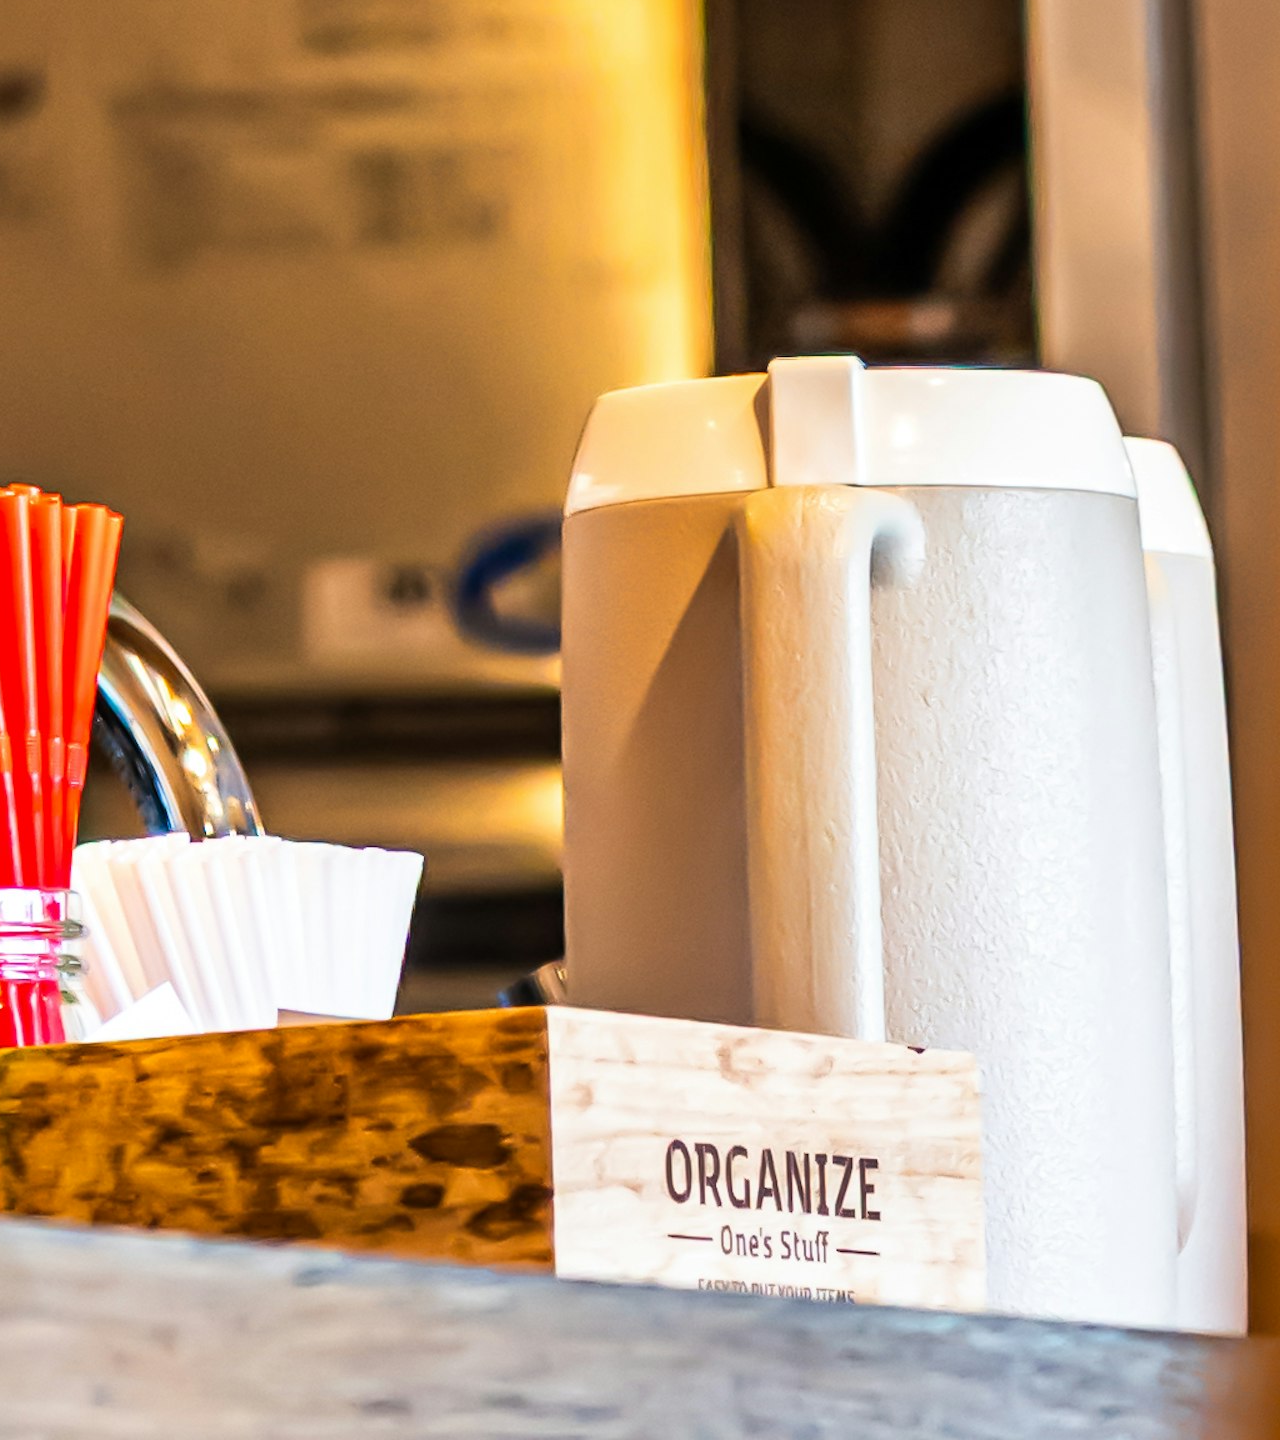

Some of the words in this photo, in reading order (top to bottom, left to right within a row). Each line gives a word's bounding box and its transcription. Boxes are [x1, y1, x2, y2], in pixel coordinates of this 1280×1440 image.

[665, 1139, 881, 1221] ORGANIZE
[720, 1224, 773, 1259] One's
[780, 1230, 830, 1263] Stuff
